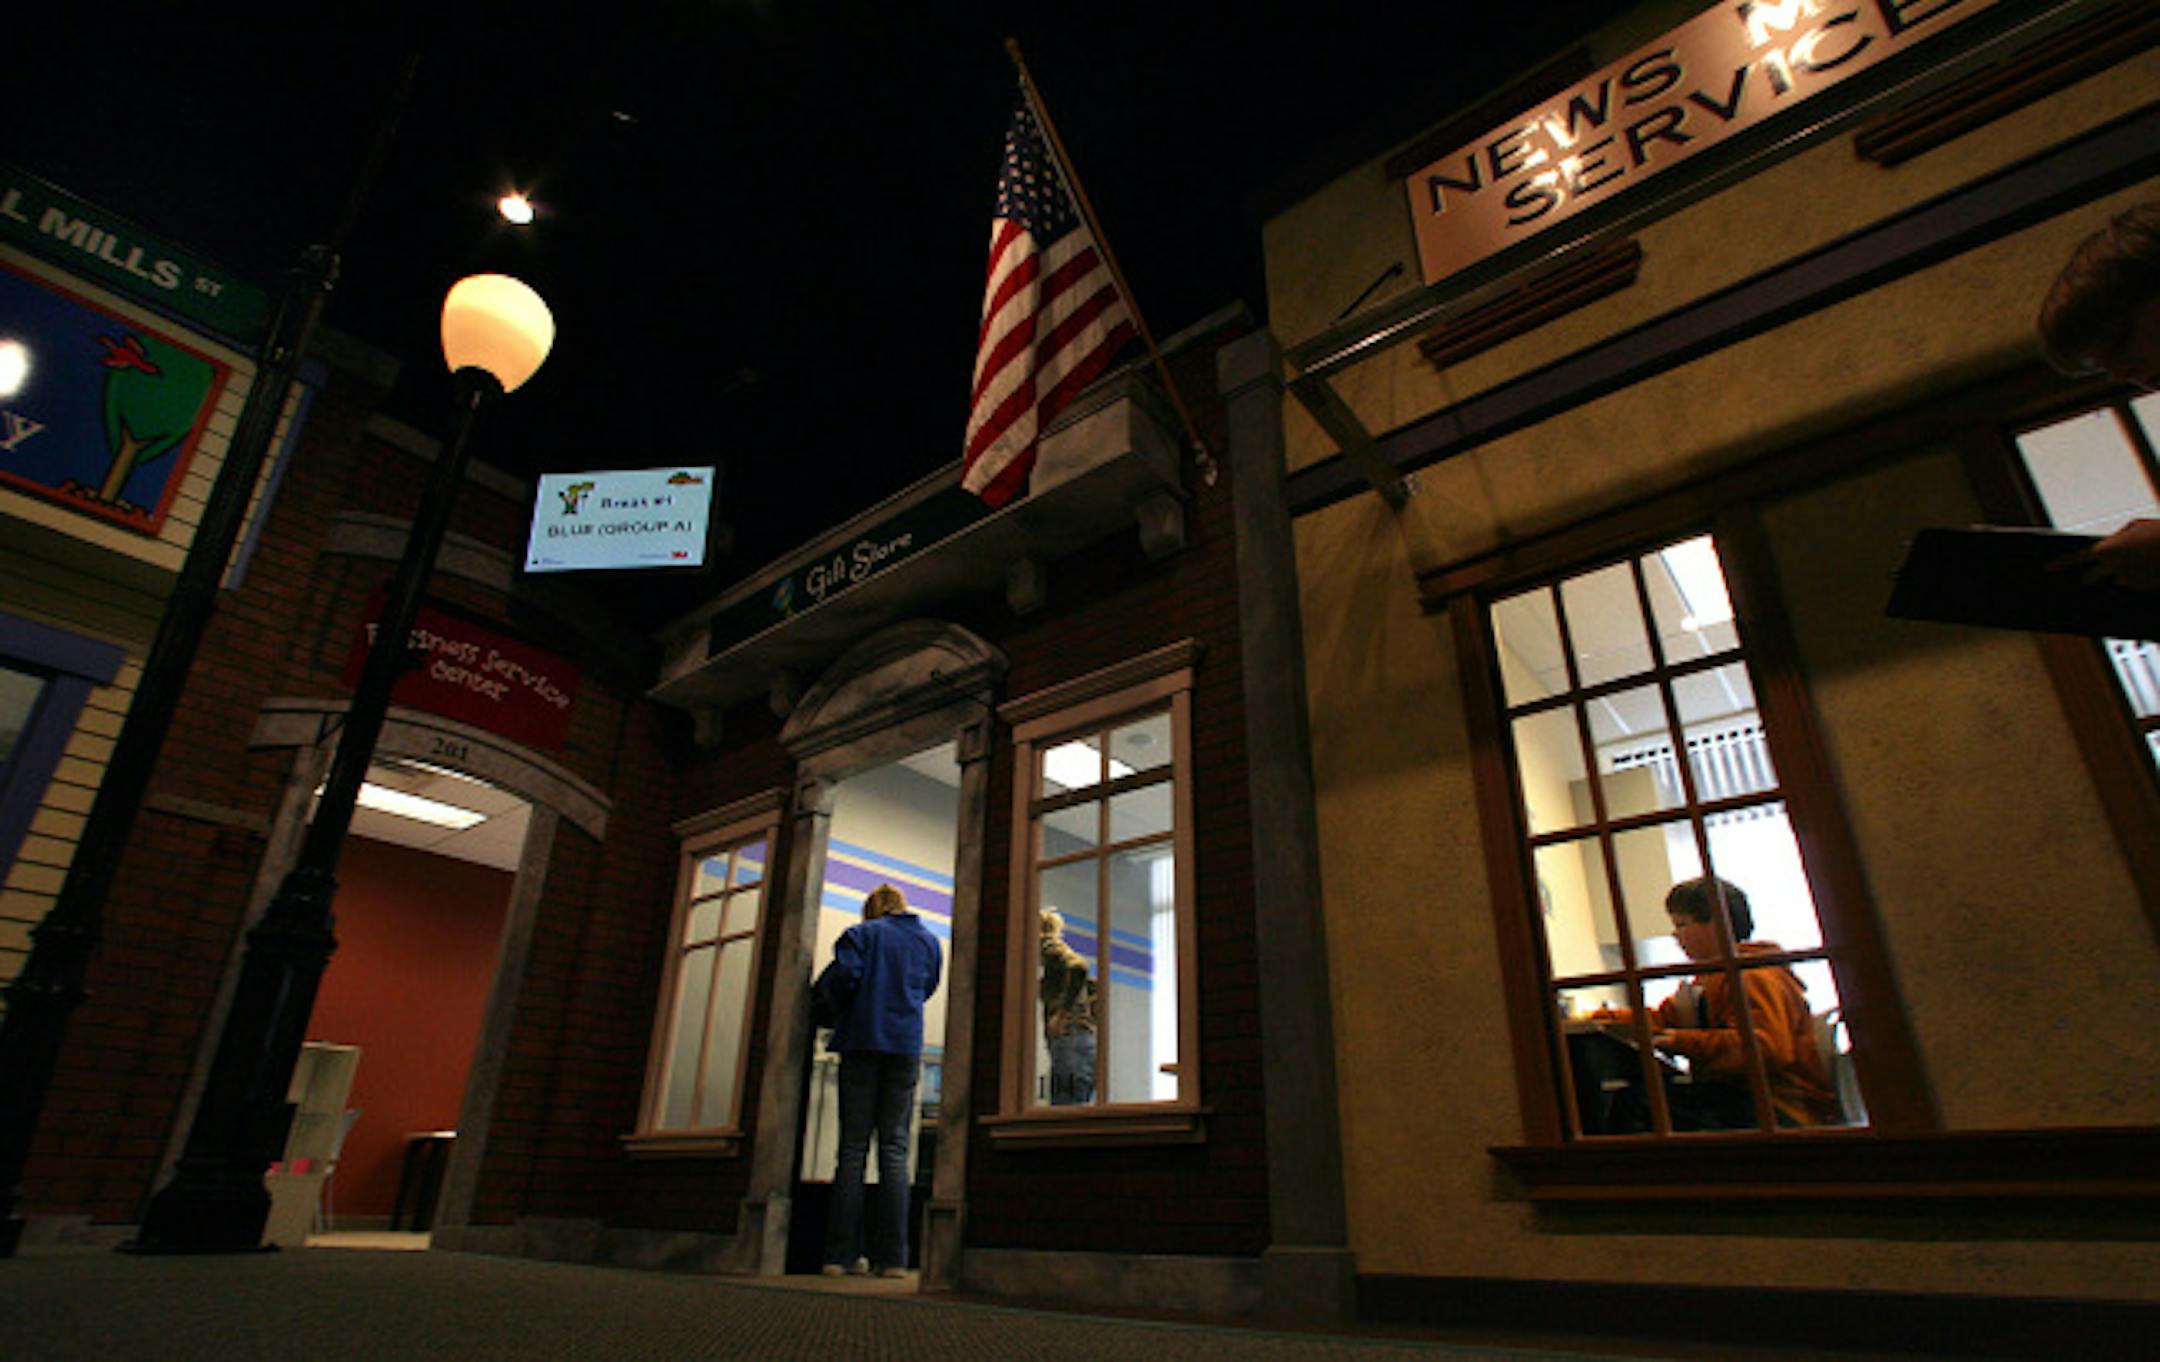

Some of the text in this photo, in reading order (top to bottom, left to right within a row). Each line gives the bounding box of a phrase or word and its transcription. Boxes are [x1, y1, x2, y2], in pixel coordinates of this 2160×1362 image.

[1427, 48, 1682, 216] NEWS
[37, 206, 183, 291] MILLS
[548, 523, 596, 540] BLUE
[598, 519, 669, 538] (GROUP
[600, 496, 649, 509] Break
[805, 532, 914, 602] Gift Store
[429, 658, 512, 701] Center
[480, 649, 572, 710] Service
